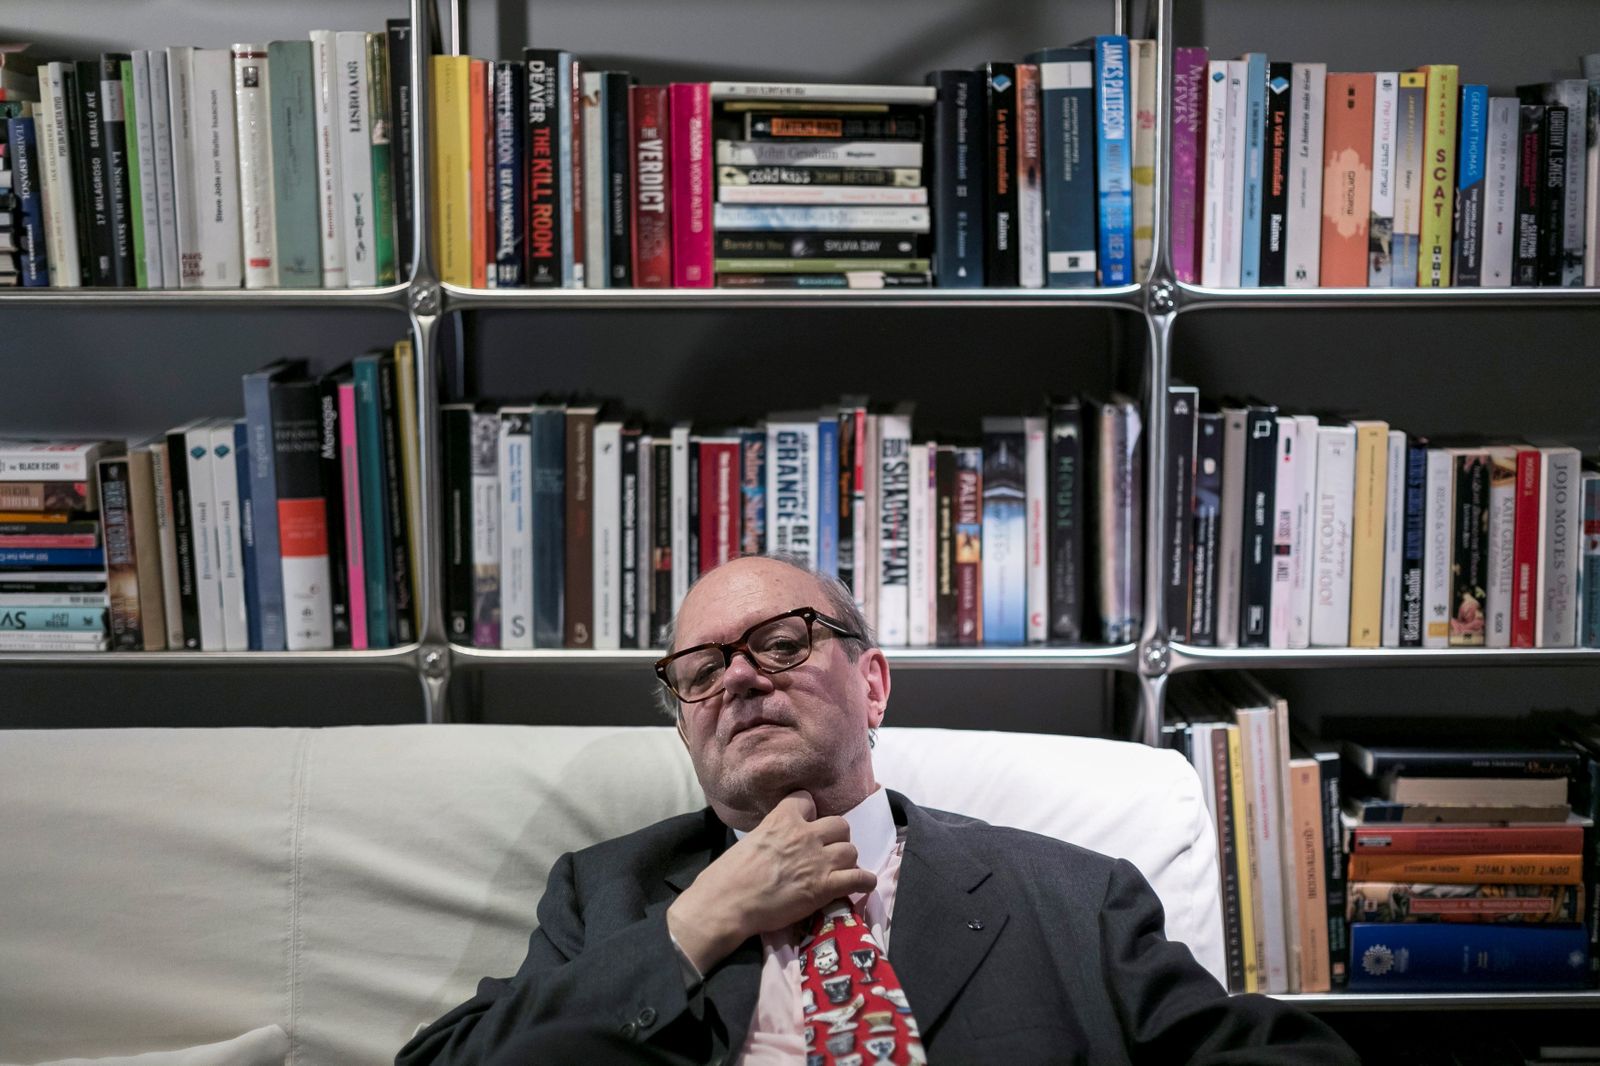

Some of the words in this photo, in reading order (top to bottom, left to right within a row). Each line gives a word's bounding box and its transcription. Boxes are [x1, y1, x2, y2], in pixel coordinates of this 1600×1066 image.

[1100, 41, 1124, 78] JAMES
[528, 60, 546, 123] DEAVER
[956, 82, 968, 106] Fifty
[1102, 79, 1124, 140] PATTERSON
[957, 107, 967, 144] Shades
[1275, 110, 1285, 123] La
[1470, 91, 1480, 133] GERAINT
[1549, 110, 1565, 147] DOROTHY
[533, 127, 551, 156] THE
[997, 123, 1008, 145] vida
[1022, 108, 1038, 160] GRISHAM
[1274, 125, 1285, 147] vida
[1468, 135, 1479, 176] THOMAS
[1548, 157, 1564, 188] SAYERS
[1569, 131, 1579, 186] NETWORK
[91, 157, 105, 211] MILAGROSO
[213, 176, 223, 197] Jobs
[532, 159, 553, 201] KILL
[637, 139, 664, 213] VERDICT
[1433, 148, 1447, 218] SCAT
[214, 199, 224, 223] Steve
[1471, 188, 1479, 202] THE
[1569, 188, 1577, 219] ALICE
[532, 203, 554, 257] ROOM
[860, 240, 882, 252] DAY
[1528, 225, 1539, 258] SLEEPING
[1569, 222, 1577, 244] THE
[19, 461, 40, 471] BLACK
[41, 461, 60, 471] ECHO
[1553, 463, 1569, 504] JOJO
[881, 461, 909, 540] SHADOW
[959, 472, 978, 524] PALIN
[1501, 496, 1514, 525] KATE
[1319, 492, 1336, 564] PICOULT
[1553, 508, 1568, 570] MOYES
[881, 546, 909, 586] MAN
[1500, 527, 1514, 595] GRENVILLE
[1318, 566, 1335, 607] JODI
[1473, 866, 1505, 876] TWICE
[1509, 866, 1538, 876] LOOK
